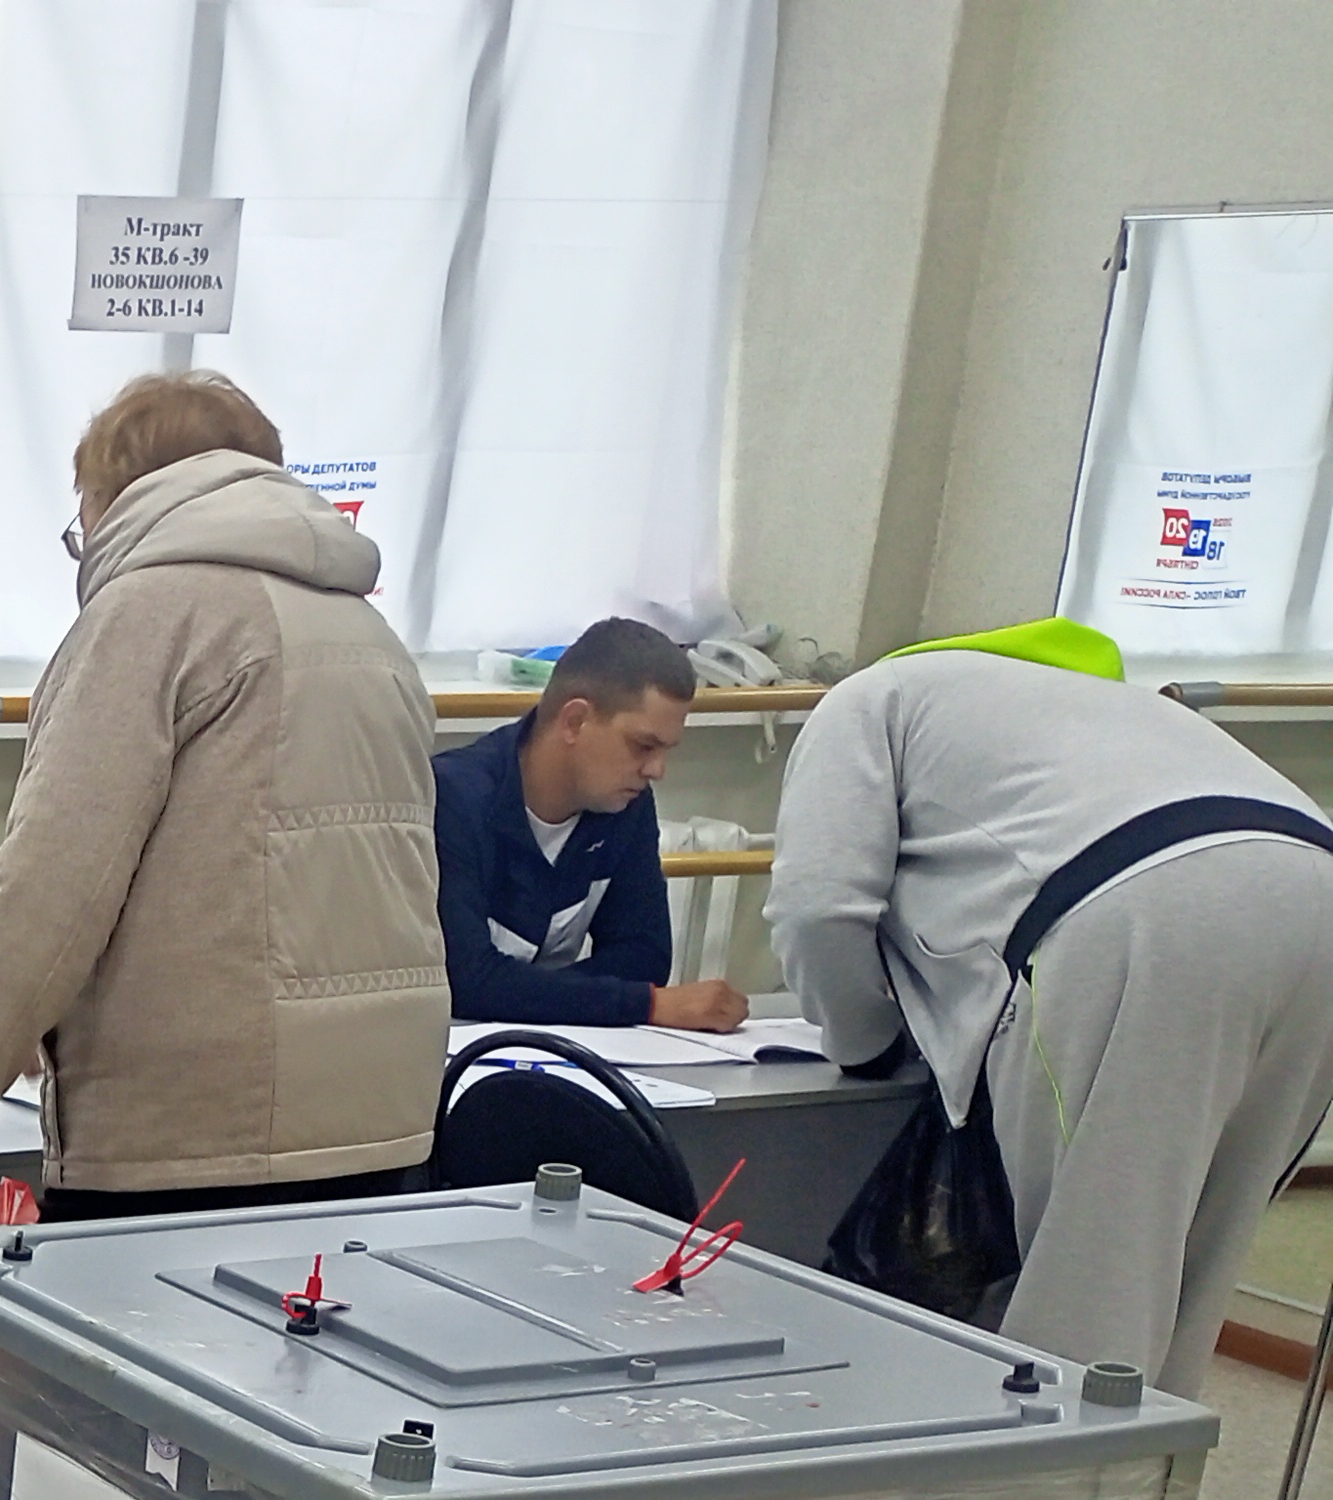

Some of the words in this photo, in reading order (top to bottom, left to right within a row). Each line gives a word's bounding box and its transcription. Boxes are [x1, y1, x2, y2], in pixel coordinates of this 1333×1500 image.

[124, 217, 203, 242] М-тракт
[109, 246, 131, 265] 35
[135, 247, 179, 265] КВ.6
[183, 247, 209, 266] -39
[91, 273, 223, 289] НОВОКШОНОВА
[106, 298, 132, 317] 2-6
[137, 299, 203, 317] КВ.1-14
[311, 461, 377, 475] ДЕПУТАТОВ
